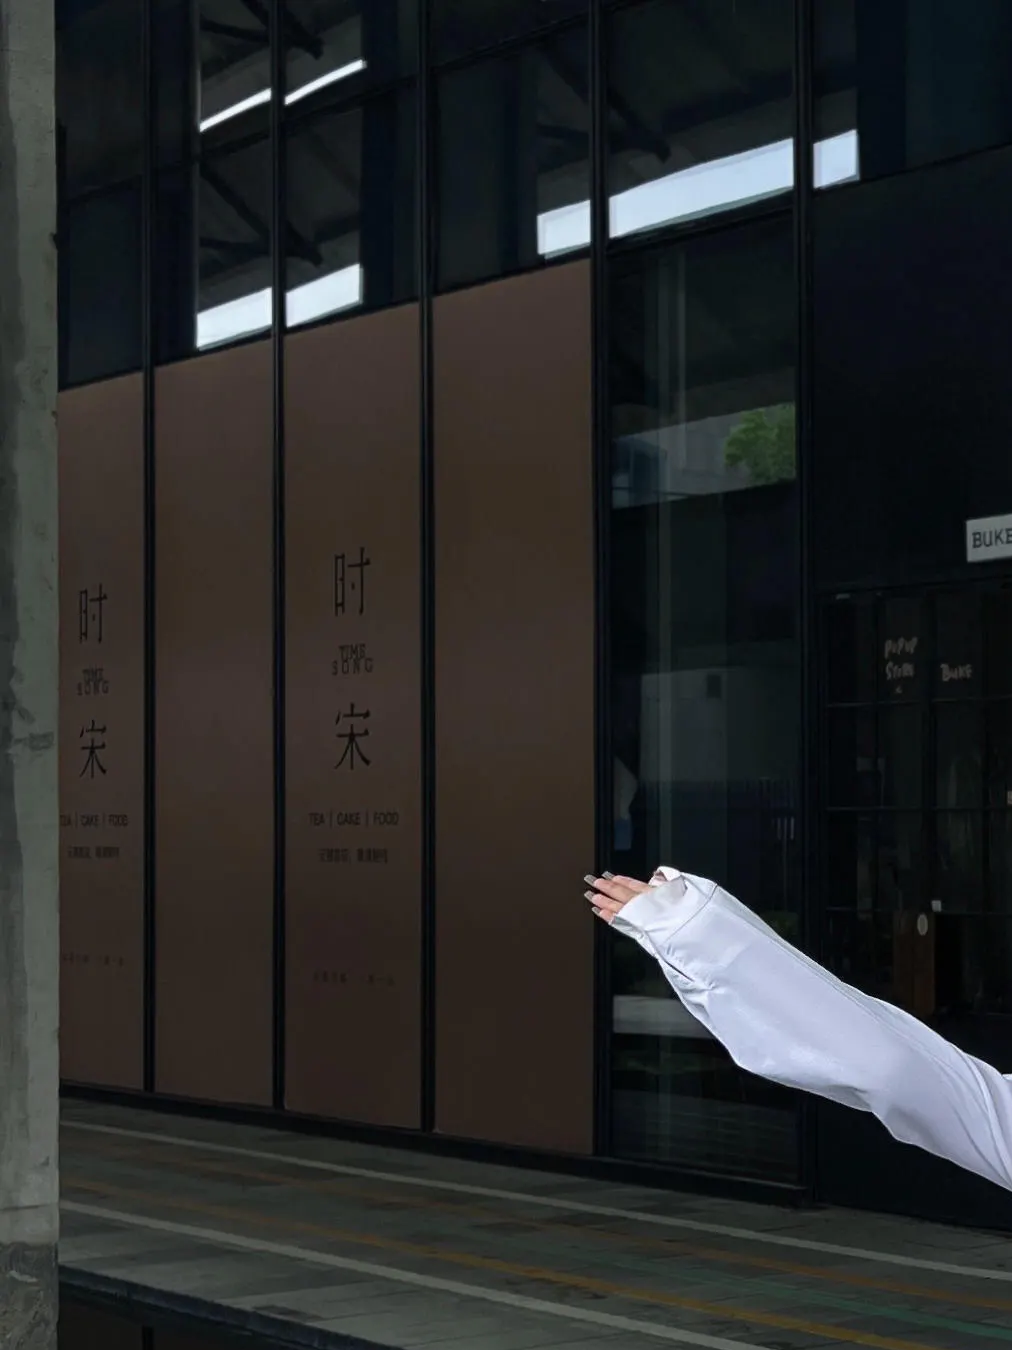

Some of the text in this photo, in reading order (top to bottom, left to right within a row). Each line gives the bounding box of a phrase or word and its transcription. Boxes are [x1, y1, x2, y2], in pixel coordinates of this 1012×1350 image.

[334, 547, 371, 616] 时
[79, 583, 108, 644] 时
[332, 658, 374, 675] SONG
[79, 719, 107, 779] 宋
[334, 702, 371, 770] 宋
[308, 811, 399, 826] TEA CAKE FOOD
